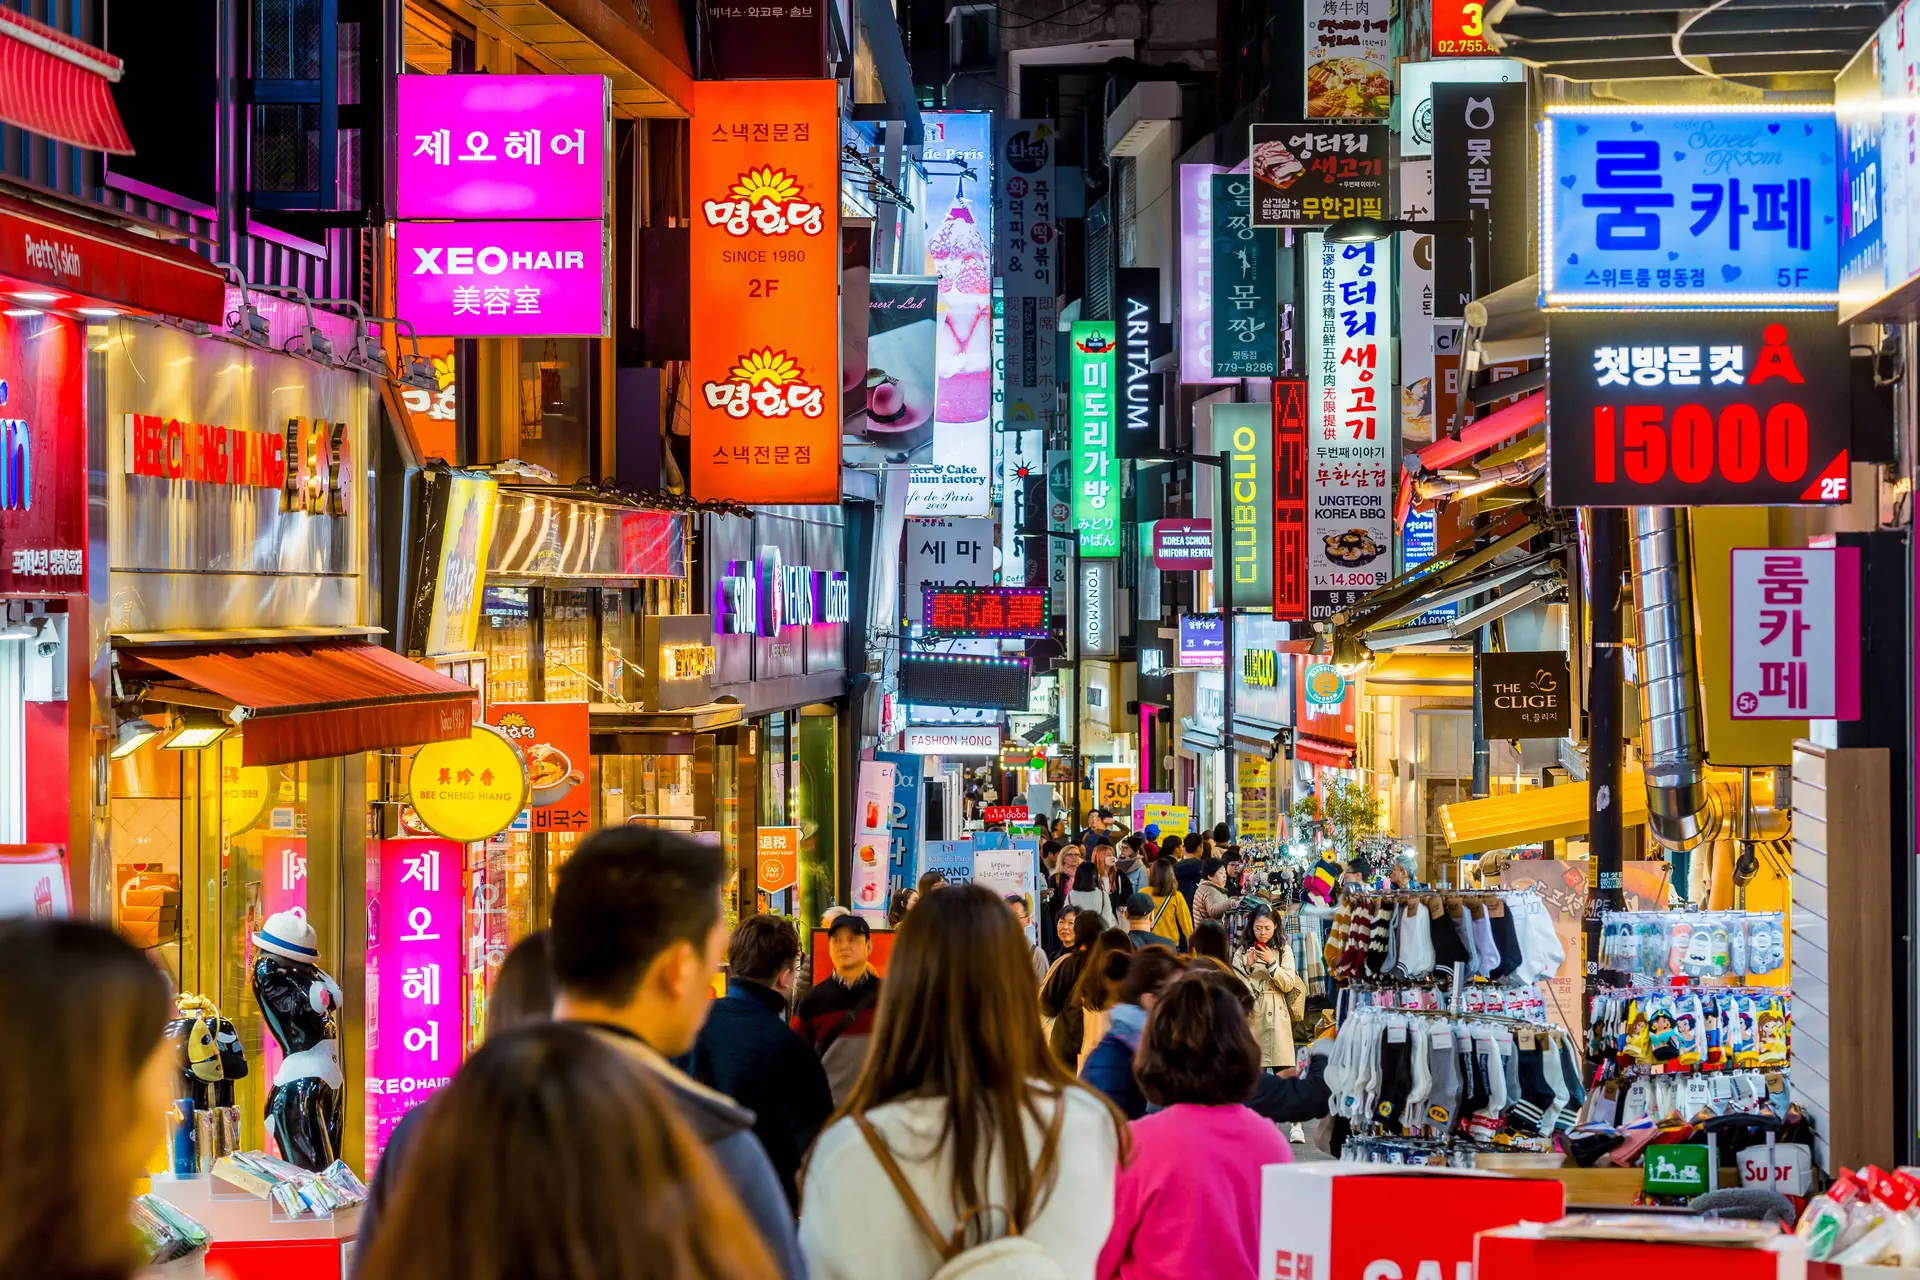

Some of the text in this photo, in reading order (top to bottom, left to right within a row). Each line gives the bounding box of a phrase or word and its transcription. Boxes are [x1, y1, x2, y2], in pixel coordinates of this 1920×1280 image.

[1323, 0, 1369, 15] 烤牛肉
[712, 123, 810, 142] 스낵전문점
[413, 129, 586, 166] 제오헤어
[1288, 133, 1369, 159] 엉터리
[1310, 156, 1382, 183] 생고기
[1302, 197, 1382, 219] 무한리필
[1851, 161, 1878, 238] HAIR
[706, 200, 824, 236] 명화당
[412, 247, 584, 275] XEO HAIR
[722, 250, 805, 263] SINCE 1980
[1585, 268, 1705, 288] 스위트룸 명동점
[1777, 268, 1810, 288] 5F
[748, 279, 779, 298] 2F
[451, 285, 542, 316] 美容室
[1227, 285, 1266, 342] 몸짱
[1127, 297, 1149, 429] ARITAUM
[1232, 351, 1257, 361] 명동점
[1594, 345, 1701, 386] 첫방문
[1708, 345, 1745, 386] 컷
[1217, 363, 1274, 373] 779-8286
[705, 380, 823, 417] 명화당
[1340, 344, 1377, 441] 생고기
[1083, 363, 1110, 508] 미도리가방
[1594, 402, 1809, 484] 15000
[133, 413, 164, 478] BEE
[167, 418, 228, 486] CHENG
[232, 428, 285, 490] HIANG
[712, 446, 811, 465] 스낵전문점
[1316, 446, 1385, 458] 두번째 이야기
[944, 464, 977, 474] Cake
[1315, 467, 1387, 488] 무한삼겹
[942, 474, 986, 486] factory
[1820, 478, 1847, 499] 2F
[925, 502, 948, 510] 2009
[1233, 426, 1257, 584] CLUBCLIO
[1318, 496, 1382, 506] UNGTEORI
[1078, 518, 1113, 529] みどり
[1315, 508, 1386, 520] KOREA BBQ
[1080, 534, 1116, 547] かばん
[1162, 536, 1211, 546] KOREA SCHOOL
[920, 540, 981, 564] 세마
[1159, 549, 1188, 558] UNIFORM
[783, 565, 812, 626] VENUS
[1088, 569, 1099, 649] TONYMOLY
[1757, 556, 1811, 709] 룸카페
[1493, 684, 1521, 693] THE
[1494, 695, 1557, 708] CLIGE
[1739, 697, 1757, 711] 5F
[911, 735, 993, 746] FASHION HONG
[420, 790, 512, 801] BEE CHENG HIANG
[531, 810, 588, 828] 비국수
[760, 835, 787, 849] 退税
[929, 866, 970, 877] GRAND
[400, 850, 440, 1062] 제오헤어
